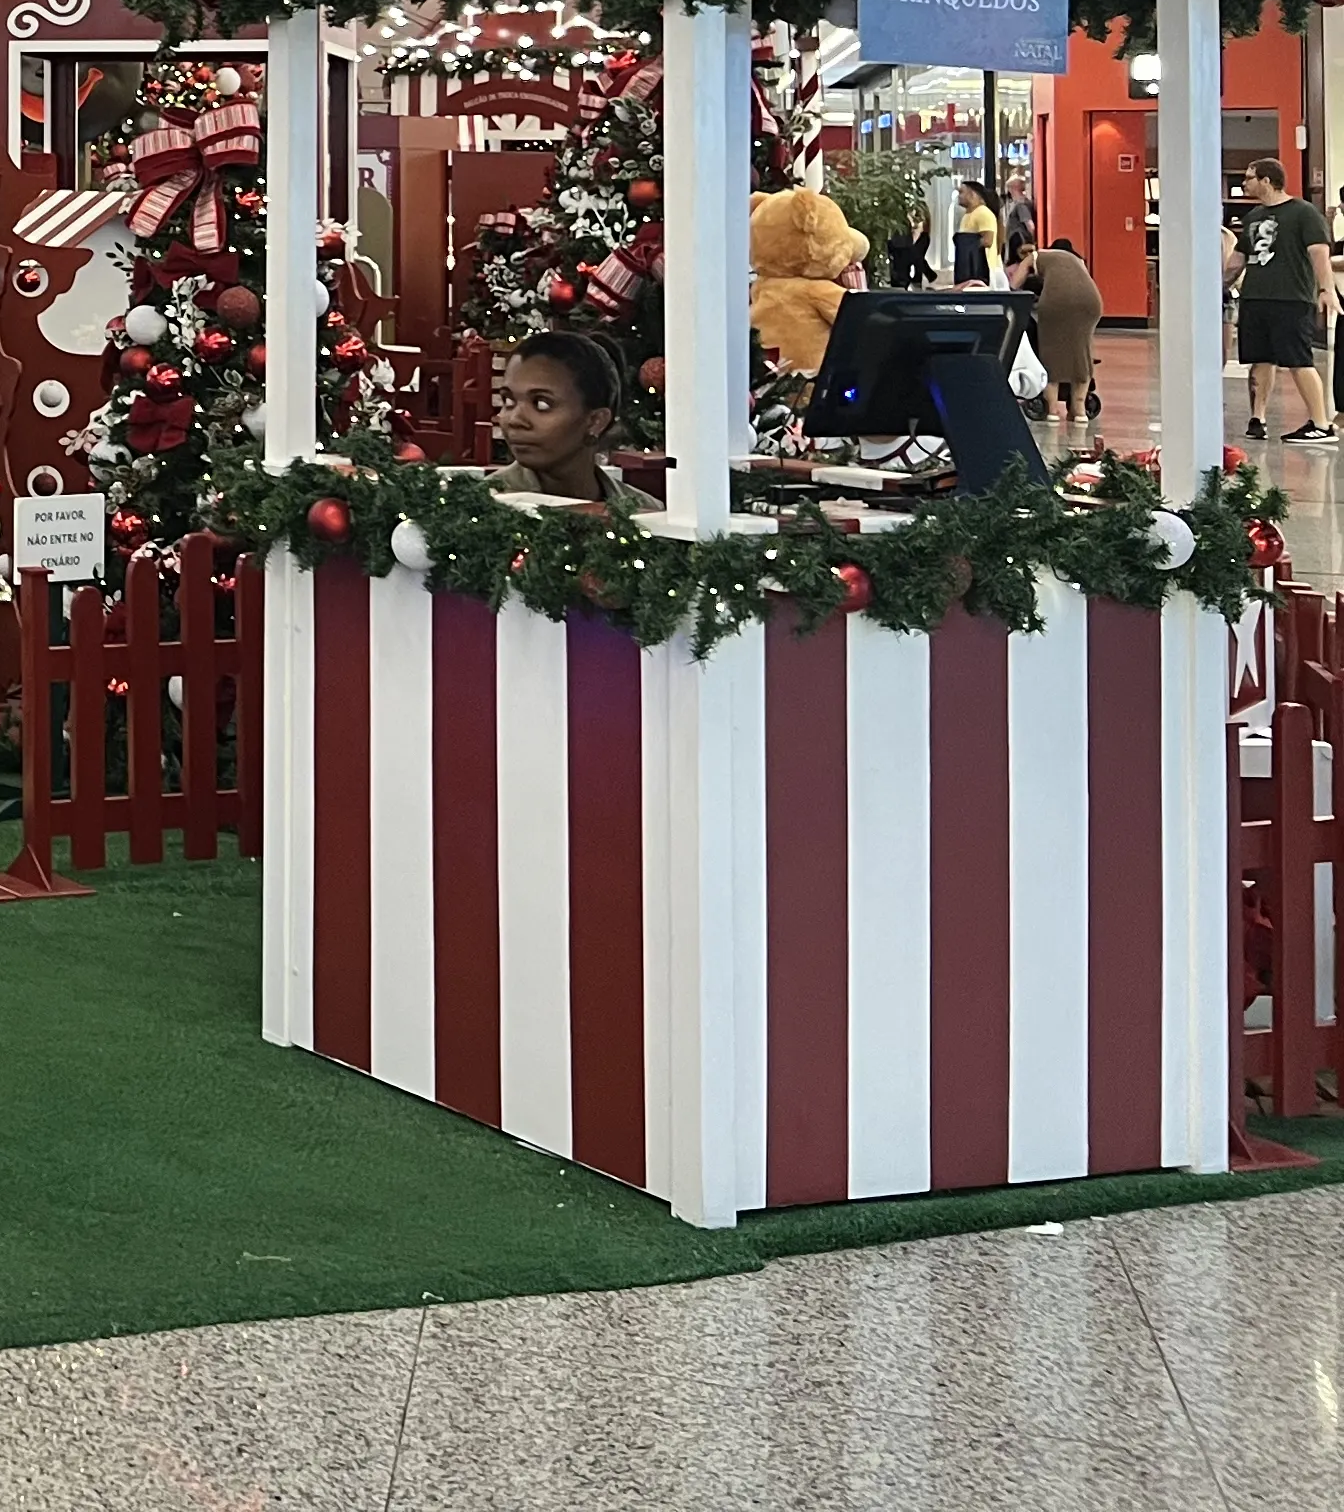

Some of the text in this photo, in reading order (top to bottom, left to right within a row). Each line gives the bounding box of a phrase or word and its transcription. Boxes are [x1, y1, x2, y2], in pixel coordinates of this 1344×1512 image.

[35, 512, 53, 522] POR
[27, 532, 93, 546] NÃO ENTRE NO
[40, 553, 80, 567] CENÁRIO
